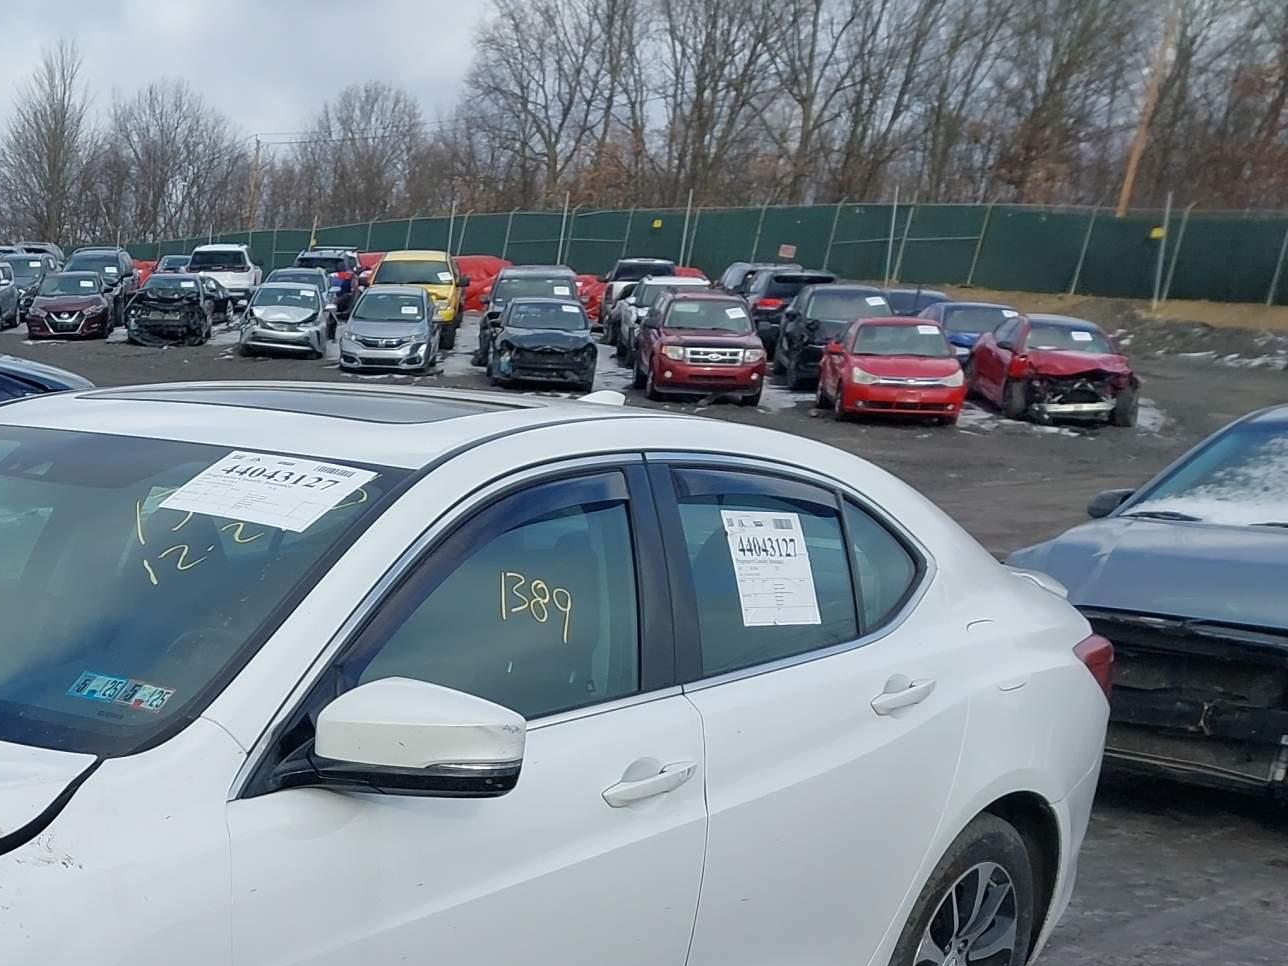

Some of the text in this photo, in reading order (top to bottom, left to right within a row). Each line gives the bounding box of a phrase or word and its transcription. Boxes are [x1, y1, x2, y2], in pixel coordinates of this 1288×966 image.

[221, 465, 340, 490] 44043127
[738, 537, 797, 557] 44043127
[501, 571, 571, 643] 1389
